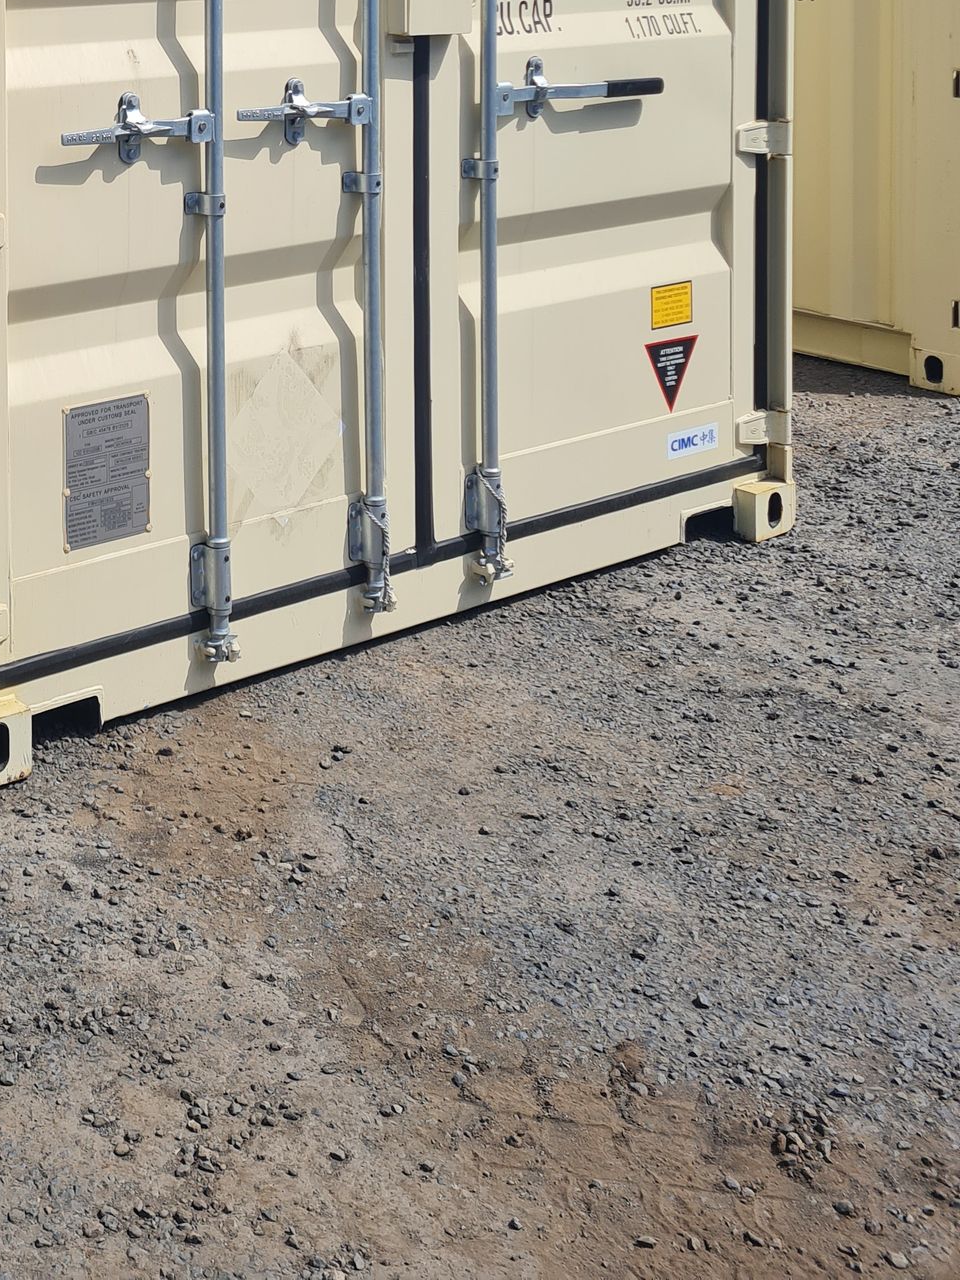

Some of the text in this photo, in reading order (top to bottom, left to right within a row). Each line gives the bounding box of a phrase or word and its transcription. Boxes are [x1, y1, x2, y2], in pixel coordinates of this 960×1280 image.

[71, 400, 143, 420] APPROVED FOR TRANSPORT
[77, 409, 136, 426] UNDER CUSTOMS SEAL
[671, 434, 698, 451] CIMC
[82, 490, 102, 499] SAFETY
[104, 484, 130, 495] APPROVAL
